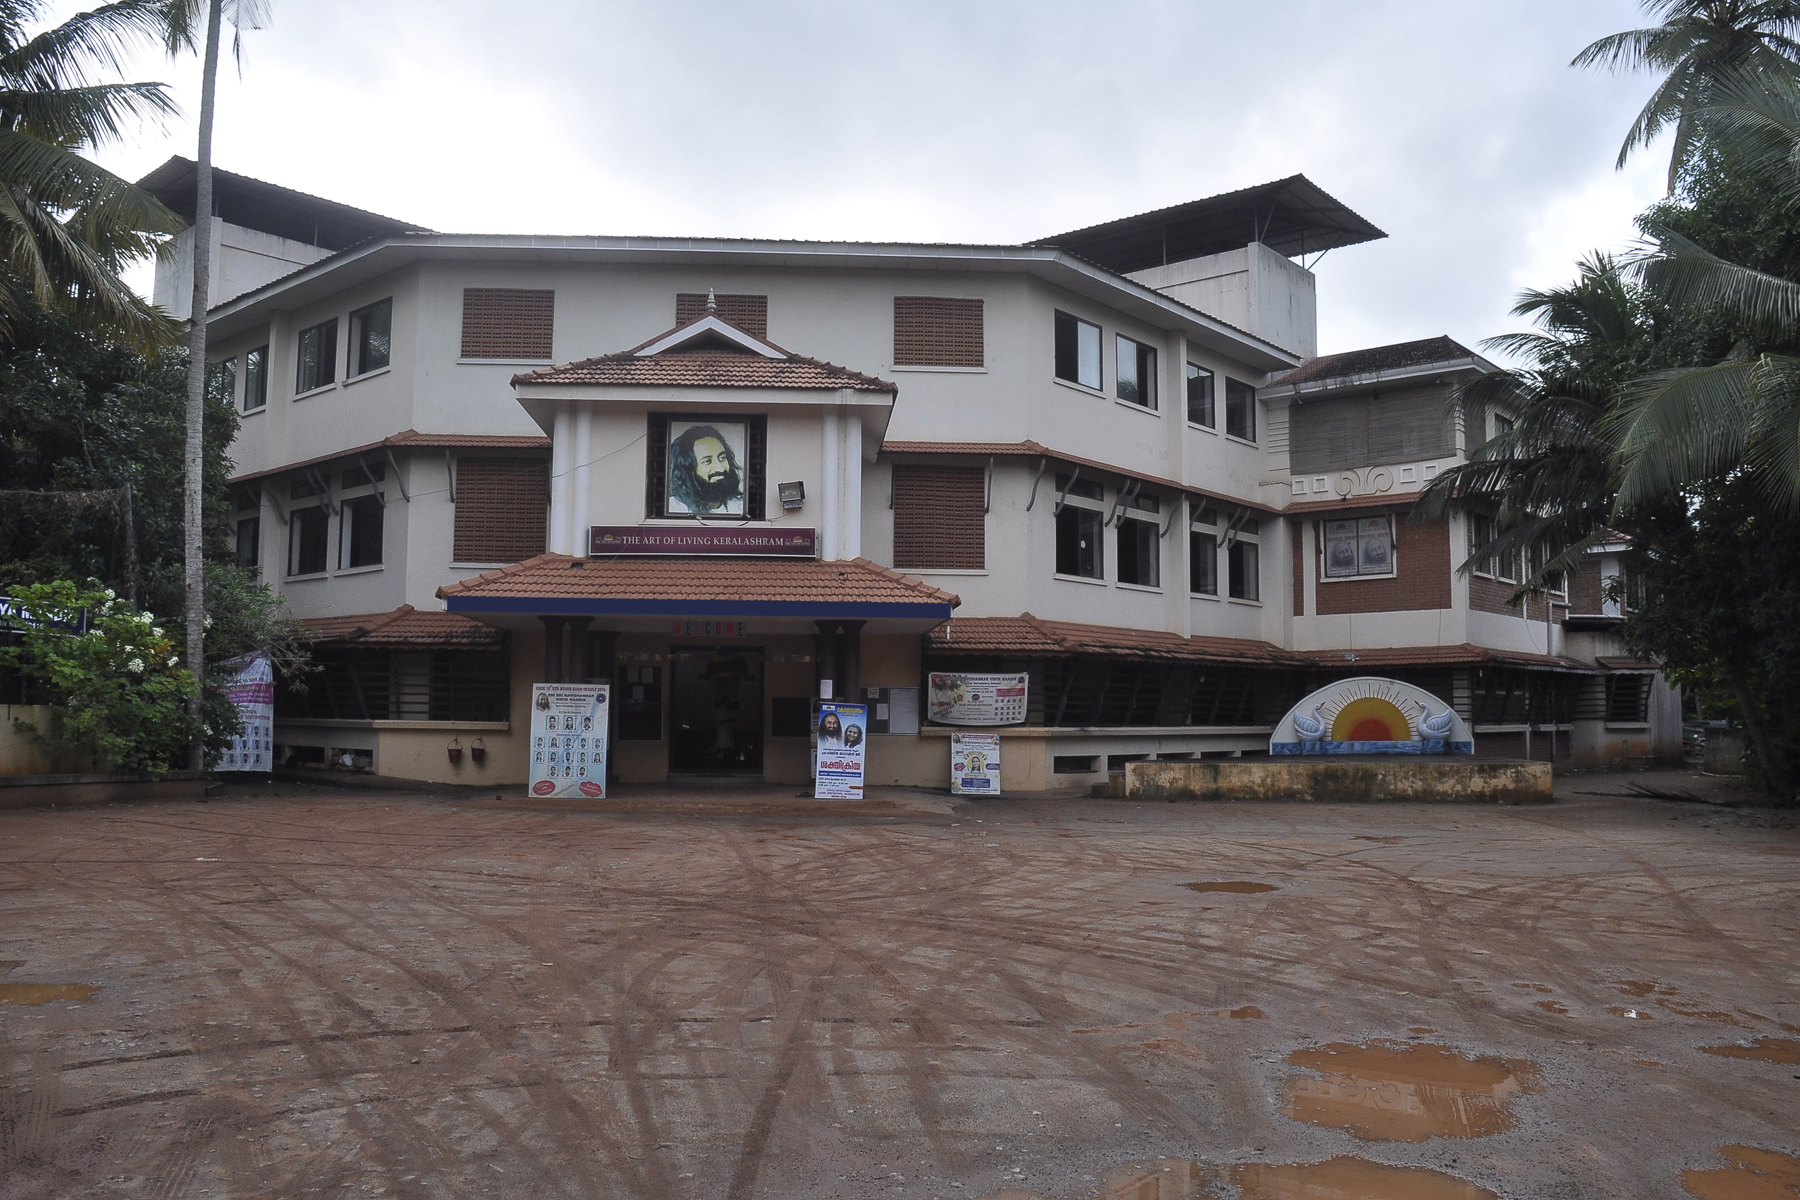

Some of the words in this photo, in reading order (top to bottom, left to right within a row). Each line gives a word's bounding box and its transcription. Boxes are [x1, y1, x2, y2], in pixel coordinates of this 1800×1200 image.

[621, 536, 641, 545] THE
[642, 536, 662, 545] ART
[663, 536, 677, 545] OF
[678, 536, 711, 546] LIVING
[713, 536, 784, 546] KERALASHRAM
[674, 621, 744, 637] WELCOME
